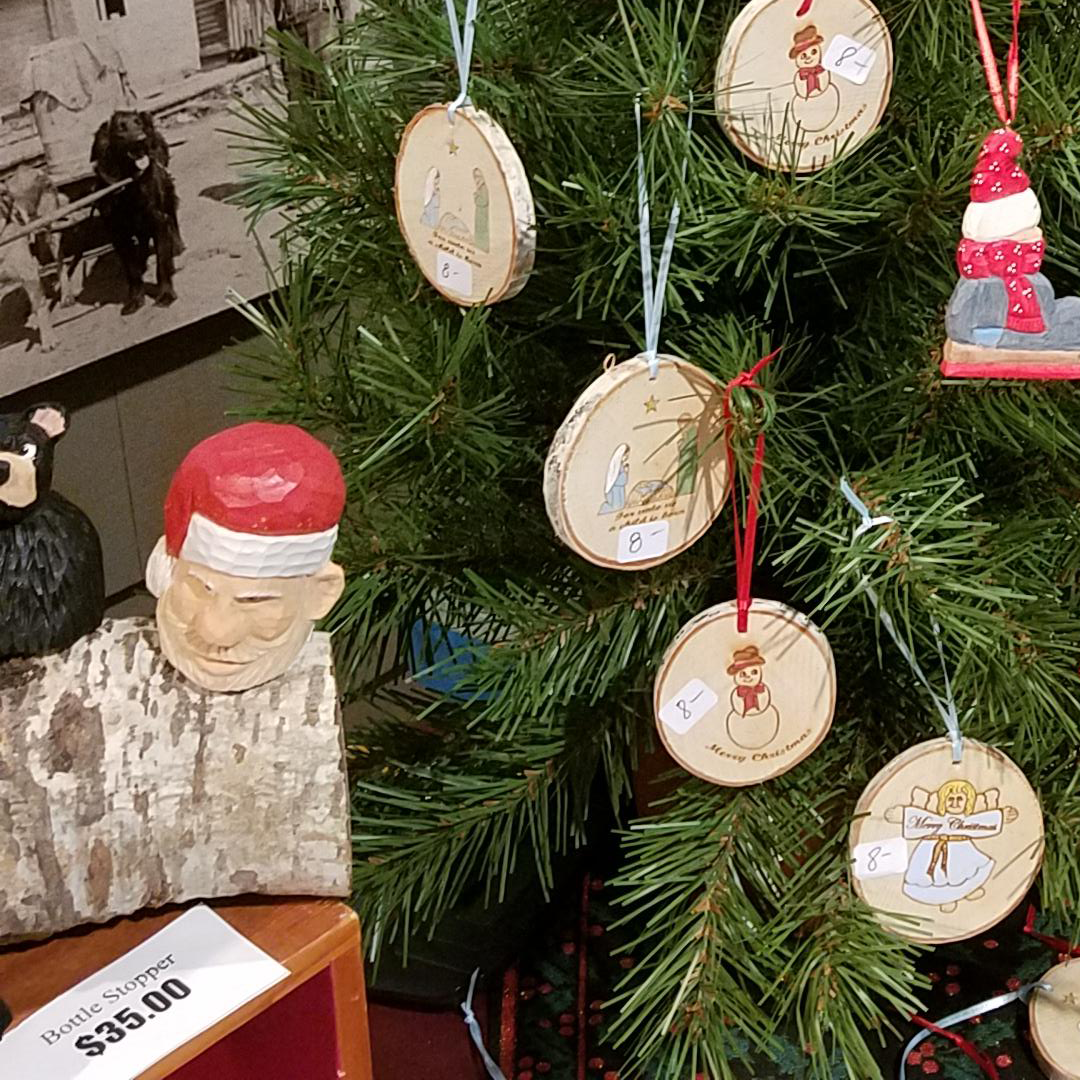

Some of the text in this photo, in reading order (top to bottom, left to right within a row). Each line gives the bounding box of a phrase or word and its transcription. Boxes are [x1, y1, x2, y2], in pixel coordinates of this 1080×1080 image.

[814, 103, 868, 147] Christmas
[706, 728, 812, 763] Merry Christmas
[905, 814, 998, 836] Merry Christmas
[40, 953, 177, 1045] Bottle Stopper
[74, 977, 192, 1057] $35.00
